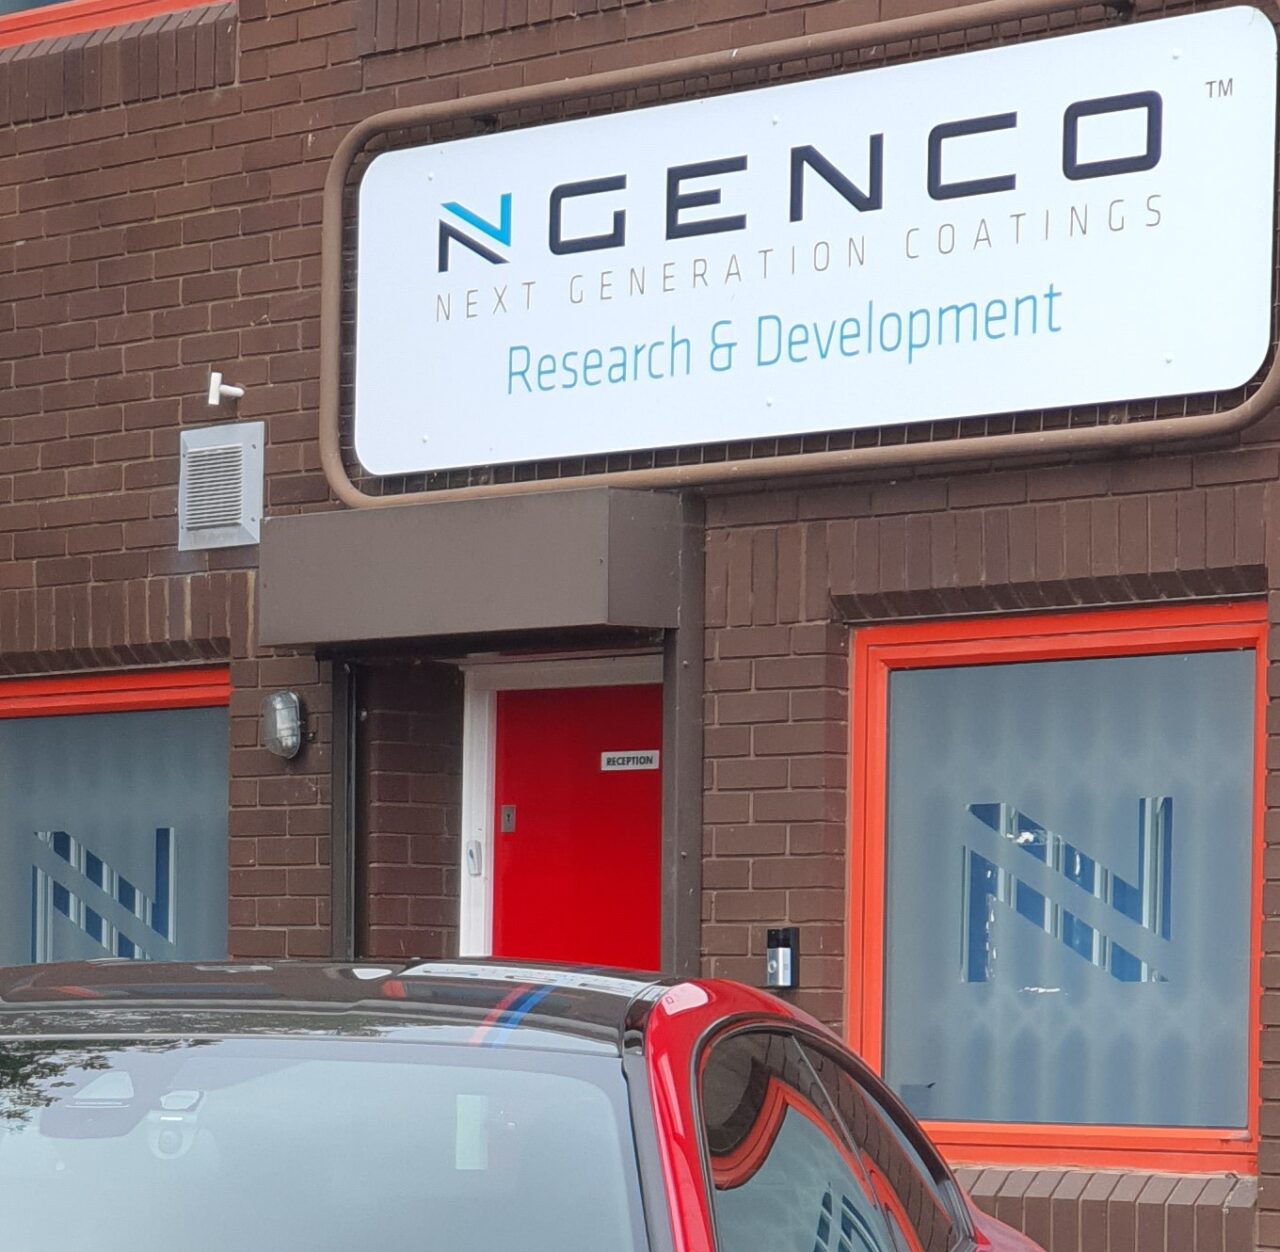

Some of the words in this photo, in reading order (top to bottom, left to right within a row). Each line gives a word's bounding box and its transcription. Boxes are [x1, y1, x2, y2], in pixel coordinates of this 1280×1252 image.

[437, 91, 1163, 273] NGENCO
[436, 281, 536, 321] NEXT
[569, 236, 867, 304] GENERATION
[905, 194, 1163, 260] COATINGS
[507, 326, 691, 395] Research
[709, 320, 738, 373] &
[756, 283, 1062, 367] Development
[606, 755, 654, 766] RECEPTION
